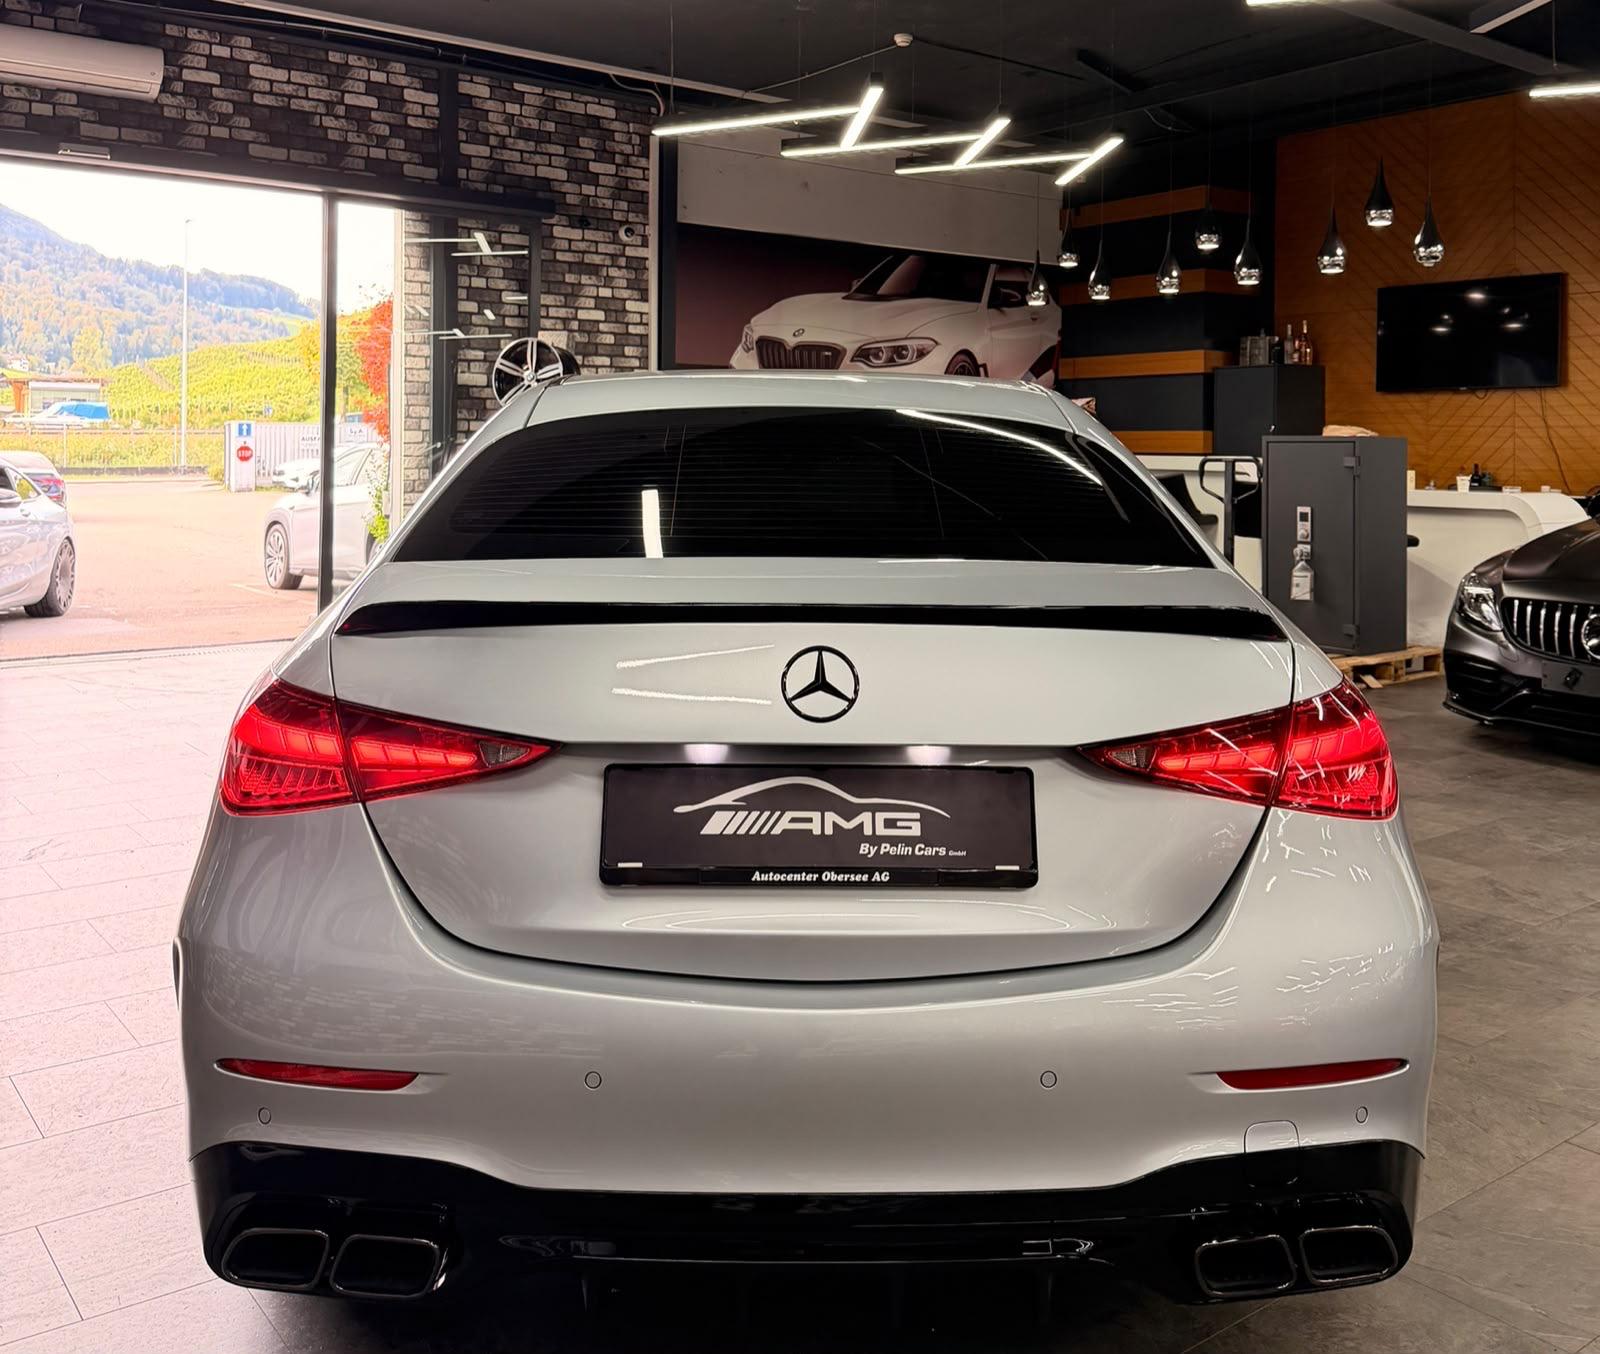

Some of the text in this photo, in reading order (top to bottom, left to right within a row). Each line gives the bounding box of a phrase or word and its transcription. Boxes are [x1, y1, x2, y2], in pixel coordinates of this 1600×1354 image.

[770, 810, 921, 836] AMG
[859, 842, 878, 858] By
[879, 843, 912, 856] Pelin
[914, 843, 947, 856] Cars
[751, 870, 890, 882] Autocenter Obersee AG
